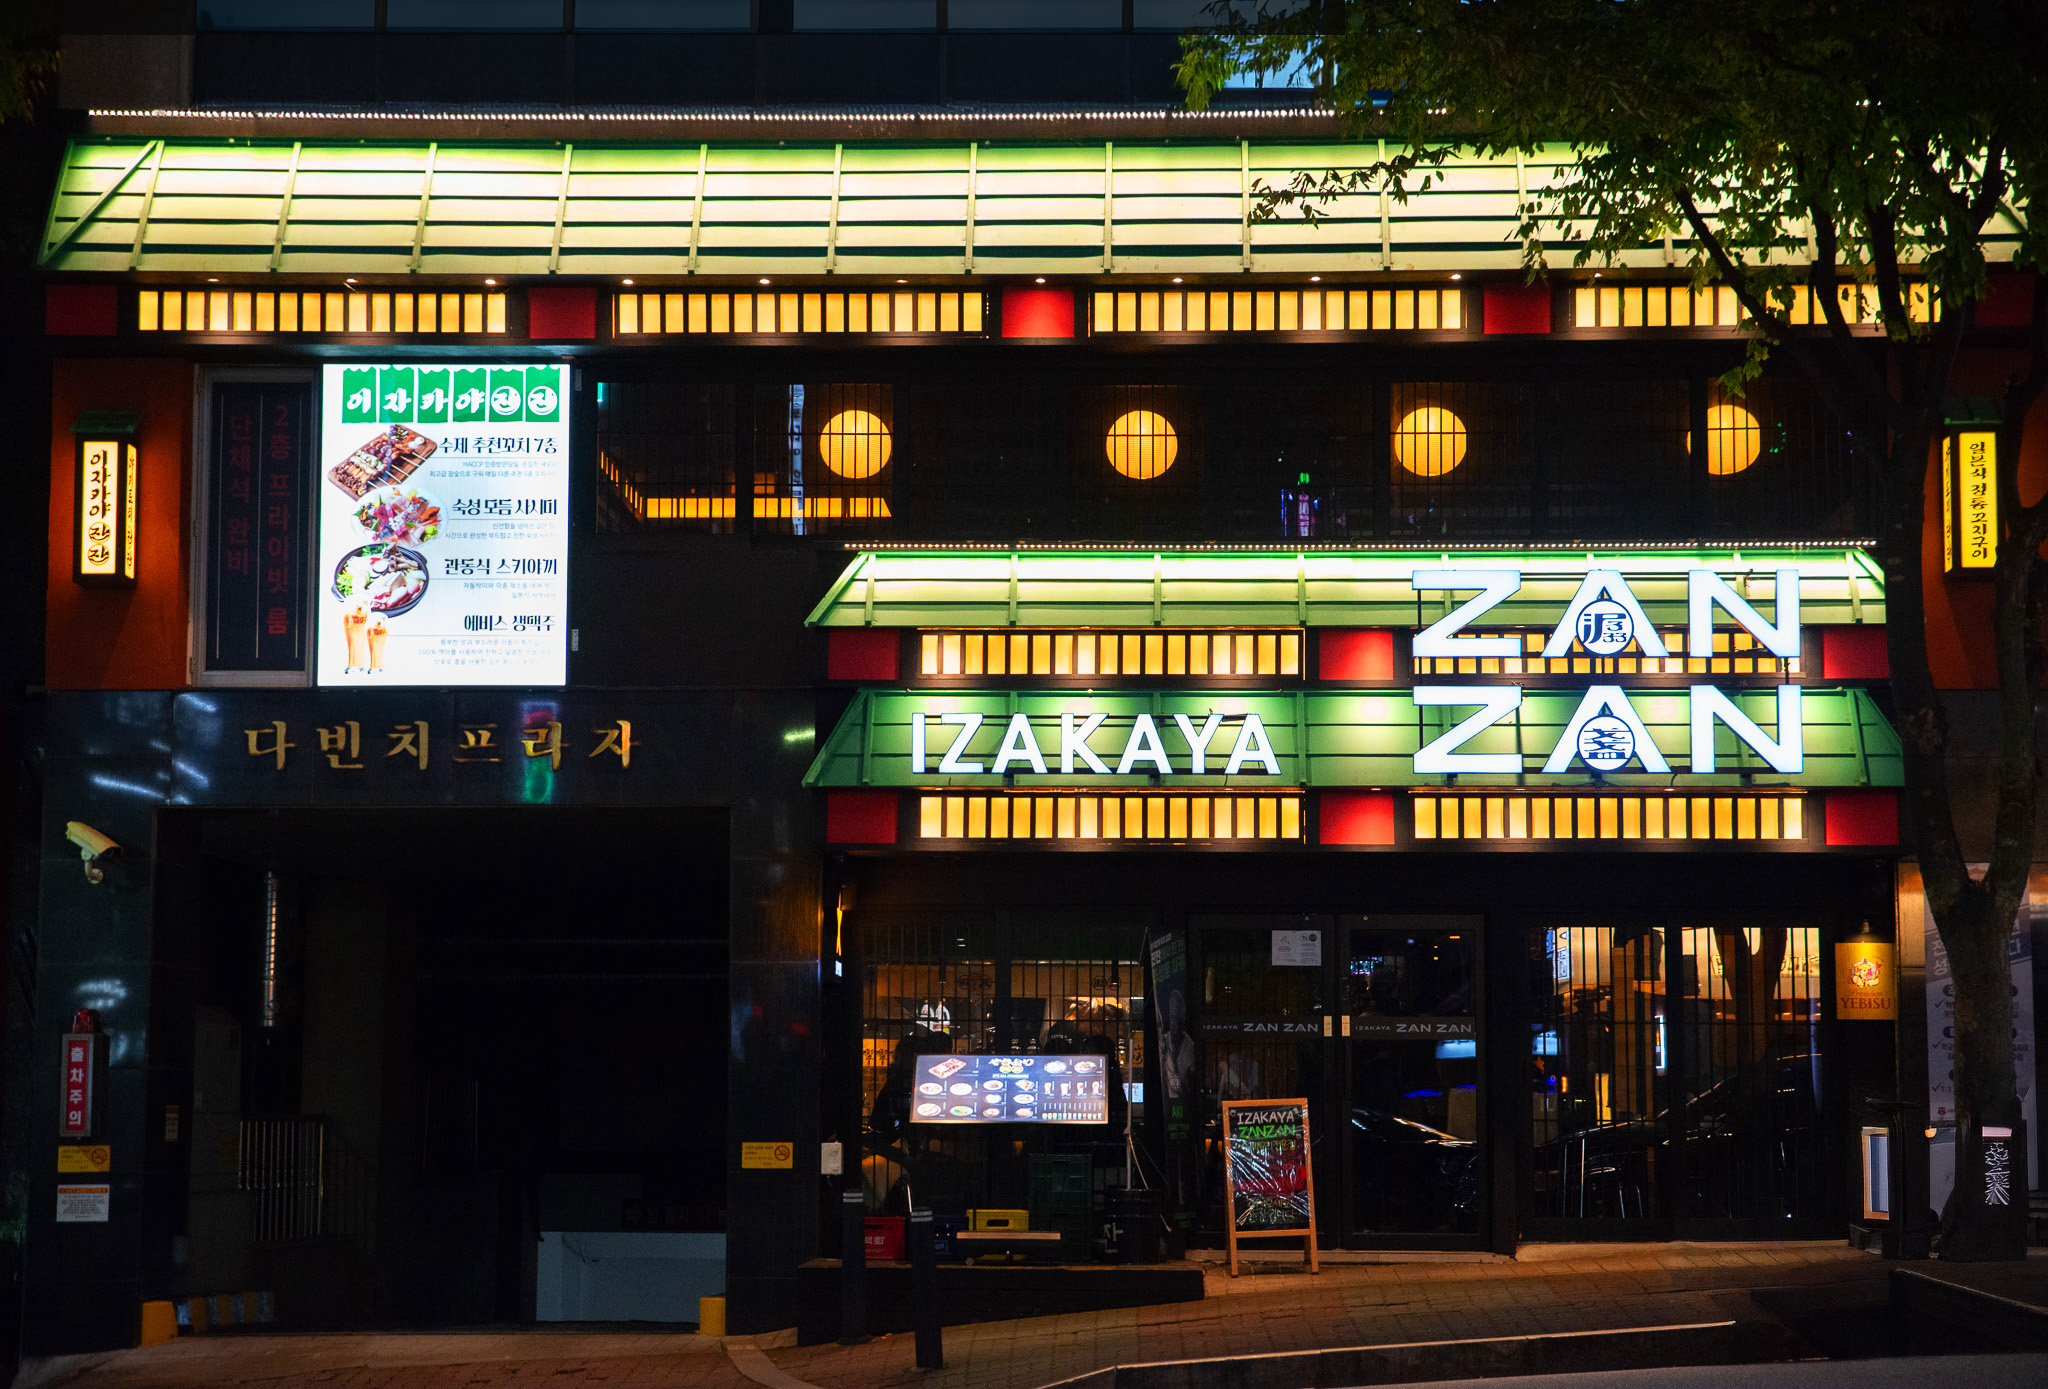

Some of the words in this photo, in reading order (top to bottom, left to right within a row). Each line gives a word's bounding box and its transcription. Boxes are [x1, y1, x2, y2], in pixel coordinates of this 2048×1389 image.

[438, 437, 468, 454] 수제
[473, 437, 530, 454] 추천꼬치
[535, 437, 558, 454] 7종
[1969, 441, 1987, 480] 일본식
[452, 498, 481, 516] 숙성
[483, 498, 513, 515] 모듬
[515, 498, 557, 516] 사시미
[268, 474, 291, 593] 프라이빗
[444, 557, 491, 575] 관동식
[496, 557, 558, 575] 스키야끼
[267, 607, 289, 634] 룸
[1411, 569, 1801, 658] ZAN
[463, 614, 508, 632] 에비스
[512, 614, 556, 632] 생맥주
[1412, 684, 1804, 774] ZAN
[911, 712, 1282, 775] IZAKAYA
[1840, 997, 1891, 1009] YEBISU
[1243, 1023, 1279, 1032] ZAN
[1283, 1023, 1319, 1032] ZAN
[1396, 1023, 1432, 1033] ZAN
[1436, 1024, 1473, 1033] ZAN
[68, 1046, 85, 1126] 출차주의
[1237, 1111, 1295, 1125] IZAKAYA
[1238, 1124, 1296, 1139] ZANZAN
